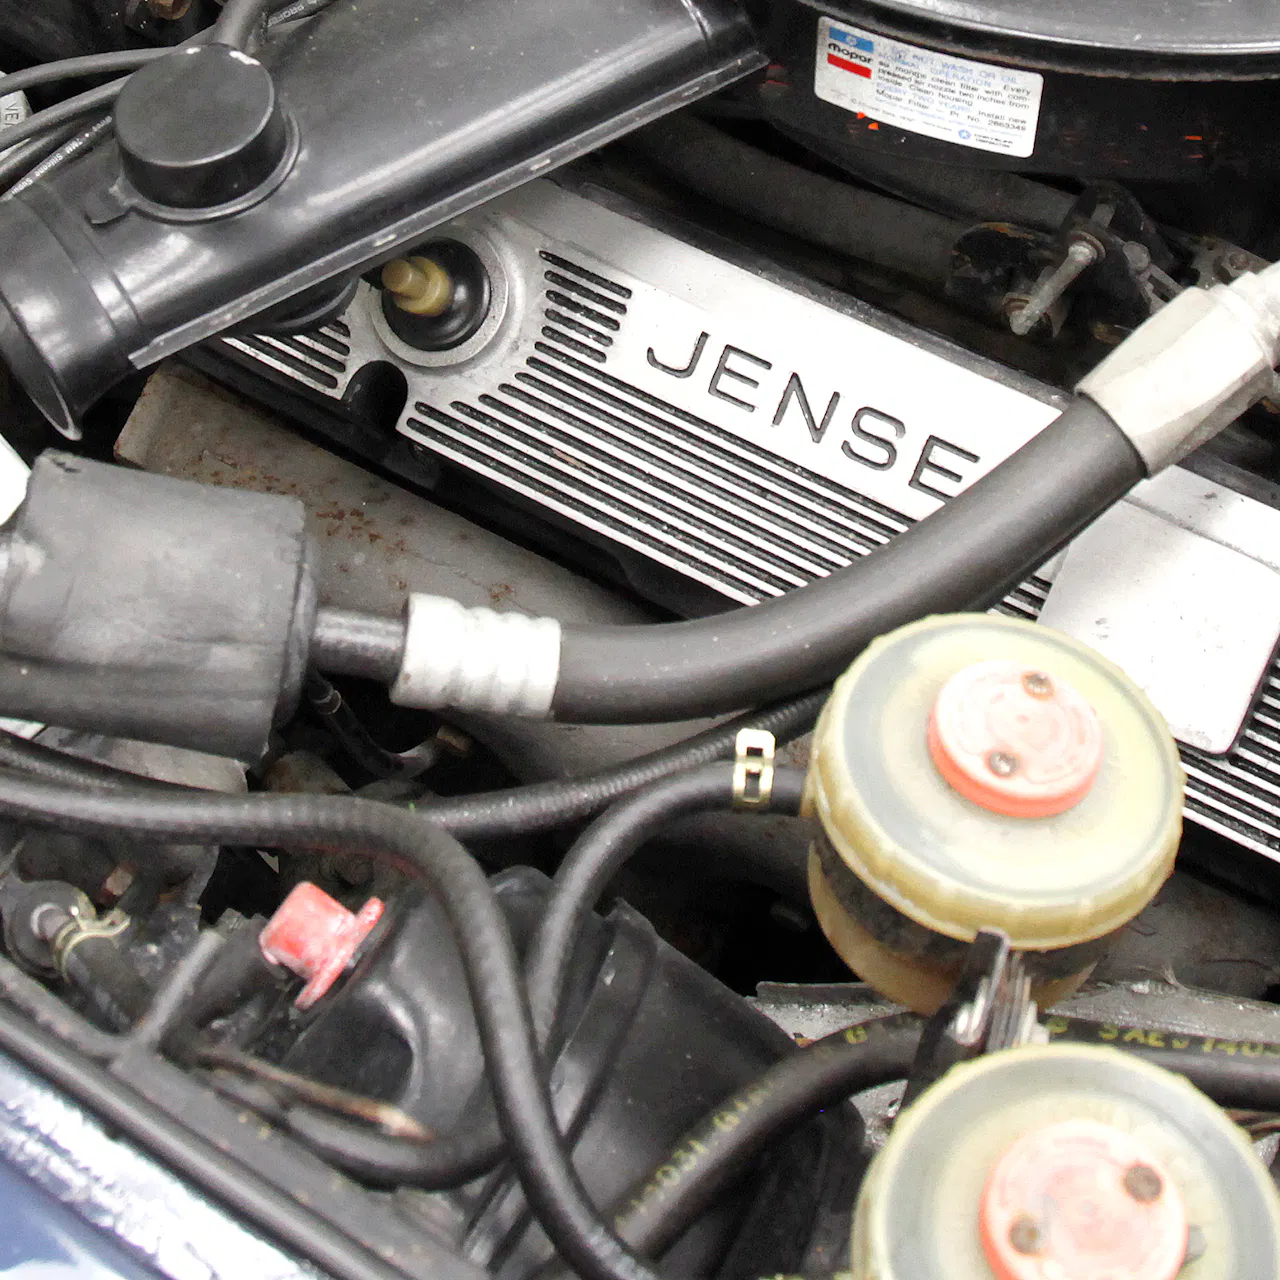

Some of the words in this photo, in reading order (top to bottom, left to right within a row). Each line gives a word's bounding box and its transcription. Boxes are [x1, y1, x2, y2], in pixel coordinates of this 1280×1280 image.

[985, 89, 1003, 97] with
[1003, 84, 1031, 95] Every
[928, 83, 956, 94] nozzle
[959, 90, 974, 99] two
[977, 95, 1005, 106] inches
[1009, 100, 1029, 109] from
[1008, 117, 1027, 125] new
[35, 152, 63, 177] Silicone
